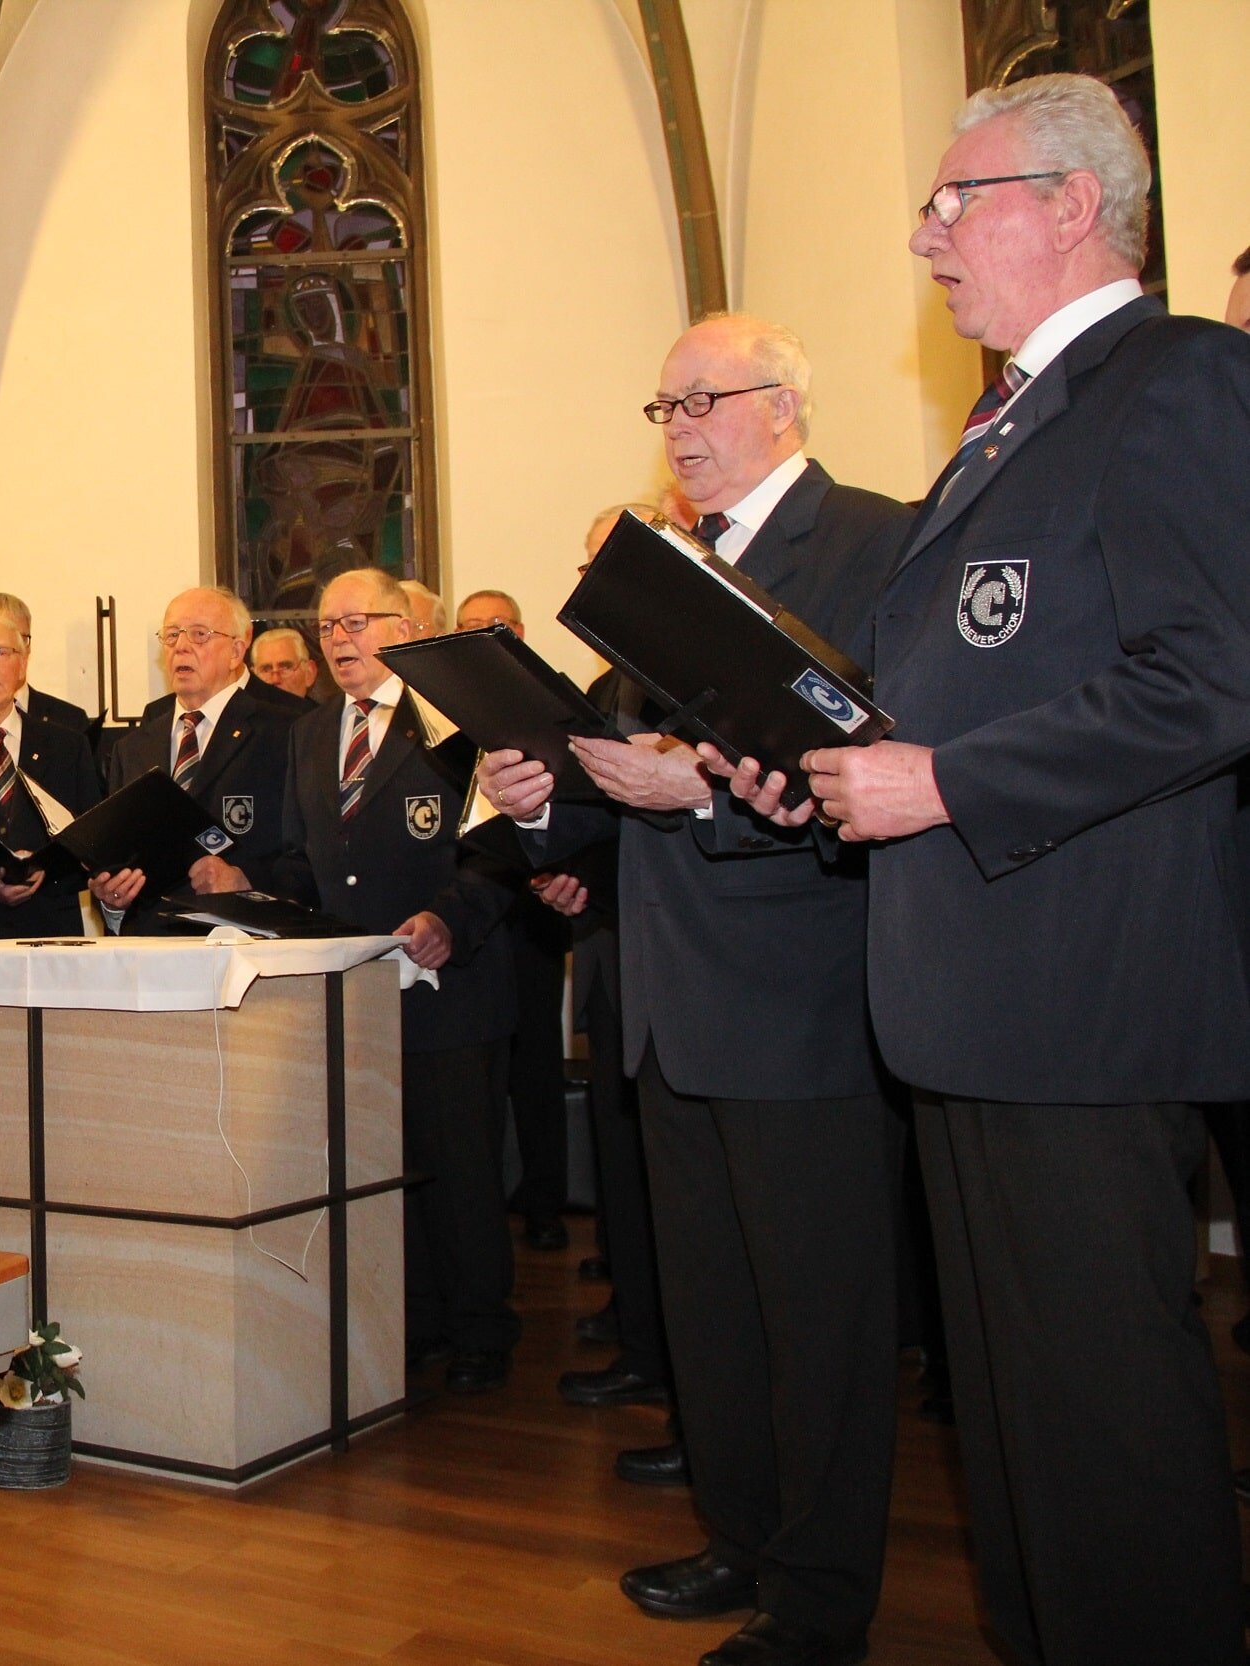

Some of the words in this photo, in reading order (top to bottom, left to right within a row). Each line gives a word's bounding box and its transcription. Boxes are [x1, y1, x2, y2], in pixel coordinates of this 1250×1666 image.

[971, 578, 1006, 626] C
[960, 612, 1020, 645] CRAEMER-CHOR
[414, 806, 432, 829] C
